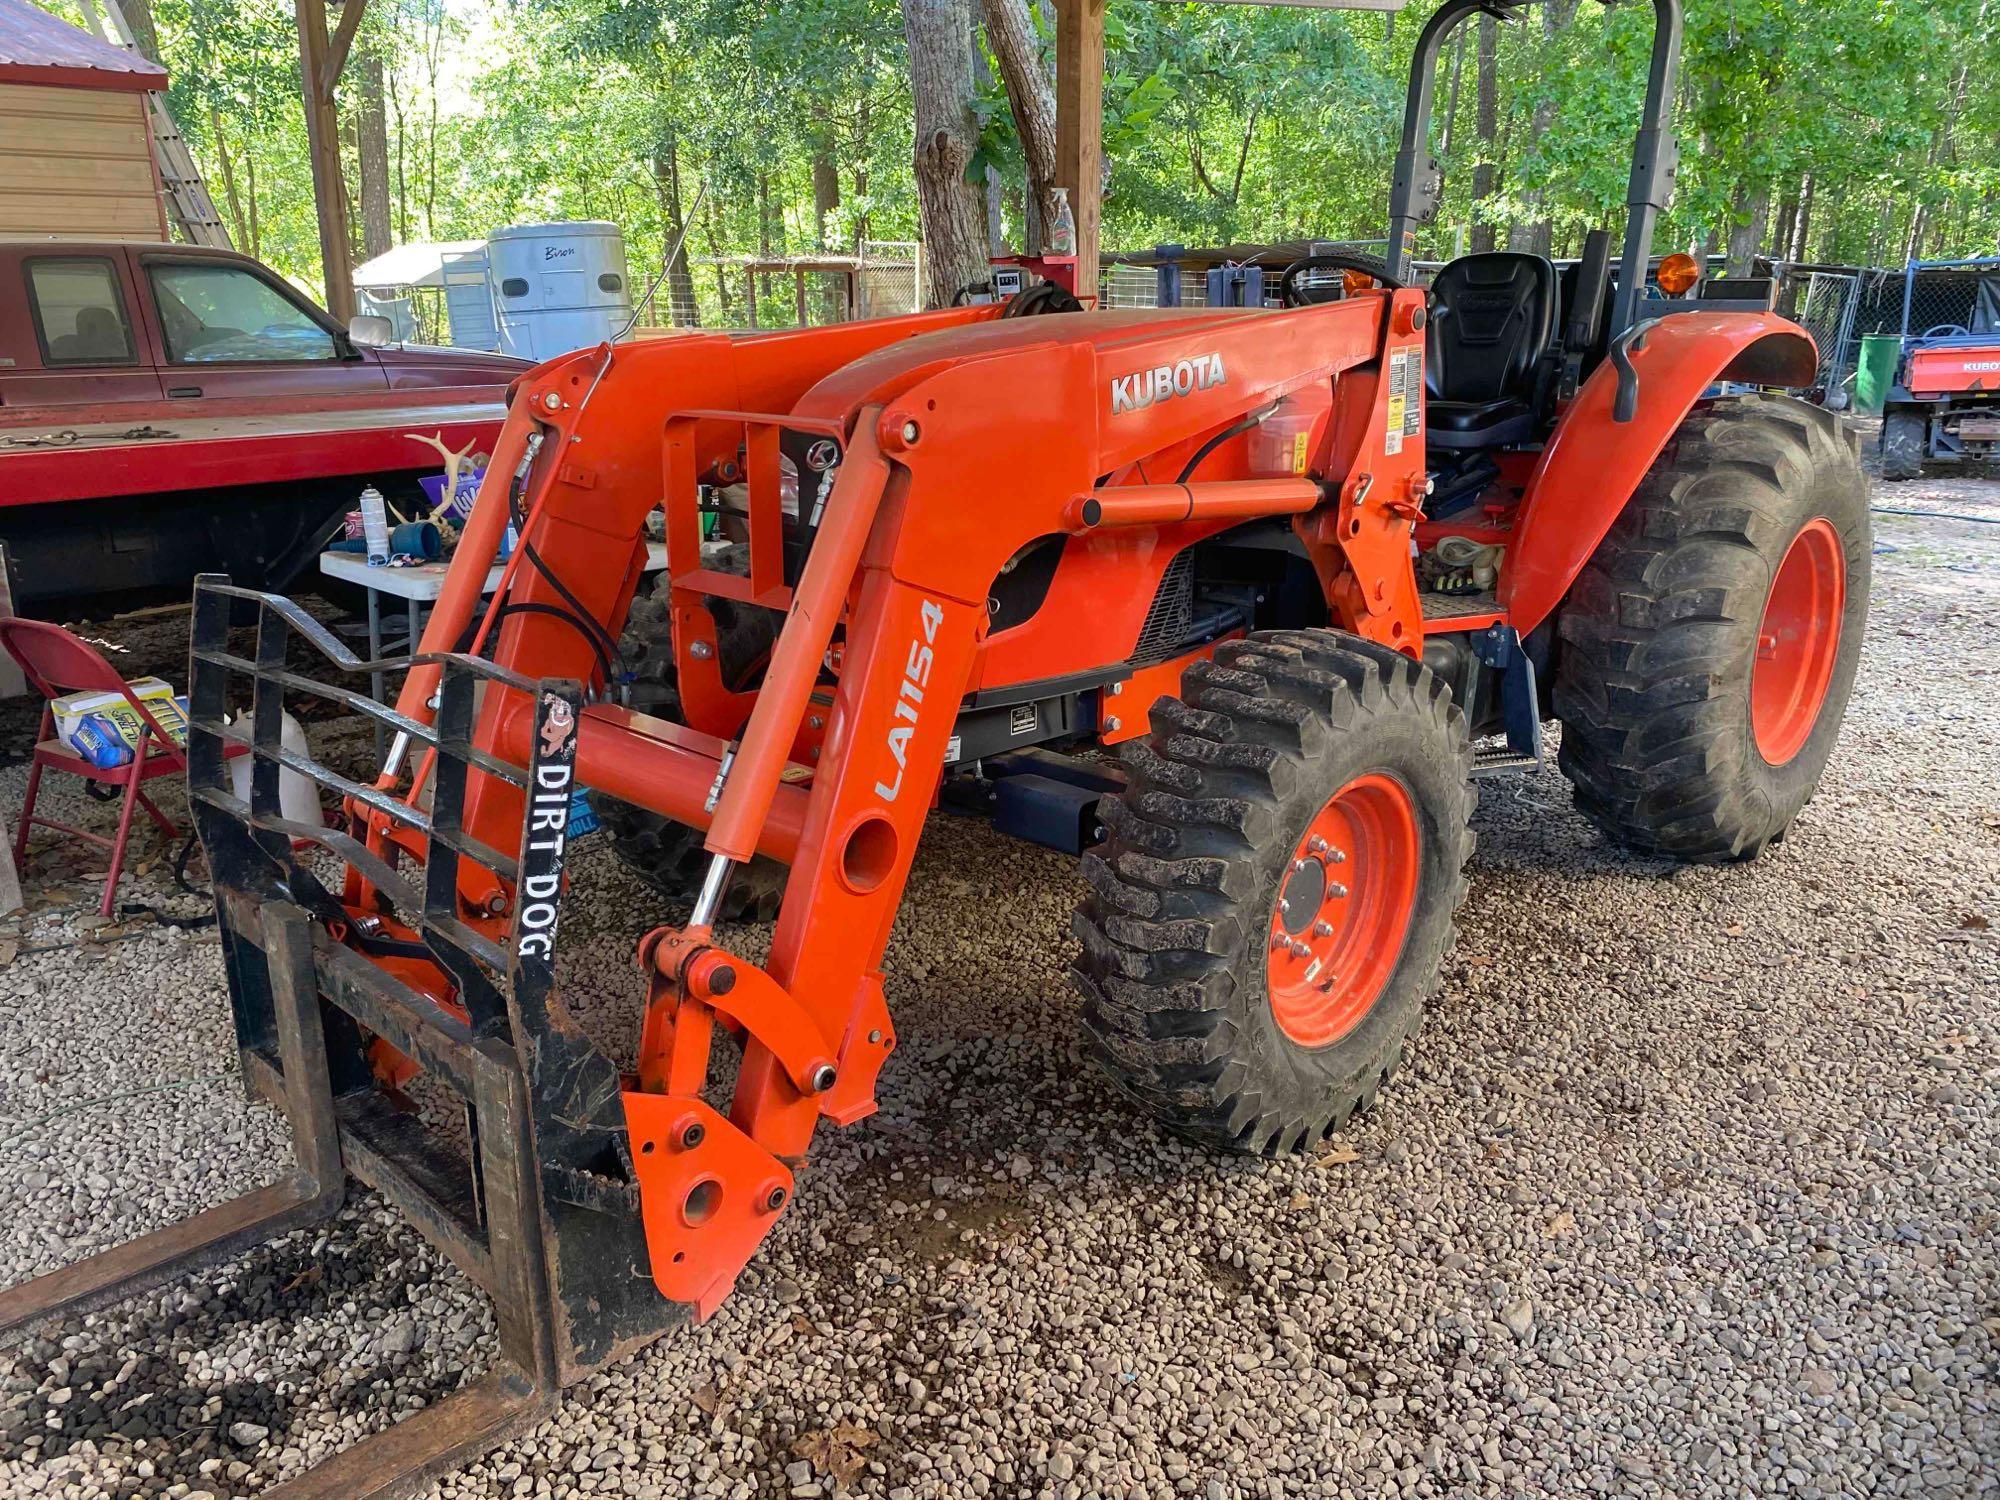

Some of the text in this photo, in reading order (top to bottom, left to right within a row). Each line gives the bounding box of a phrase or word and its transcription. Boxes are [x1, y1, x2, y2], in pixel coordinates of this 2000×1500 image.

[1111, 352, 1227, 415] KUBOTA
[1963, 361, 2000, 372] KUBO
[875, 599, 943, 801] LA1154
[519, 765, 571, 960] DIRT DOG
